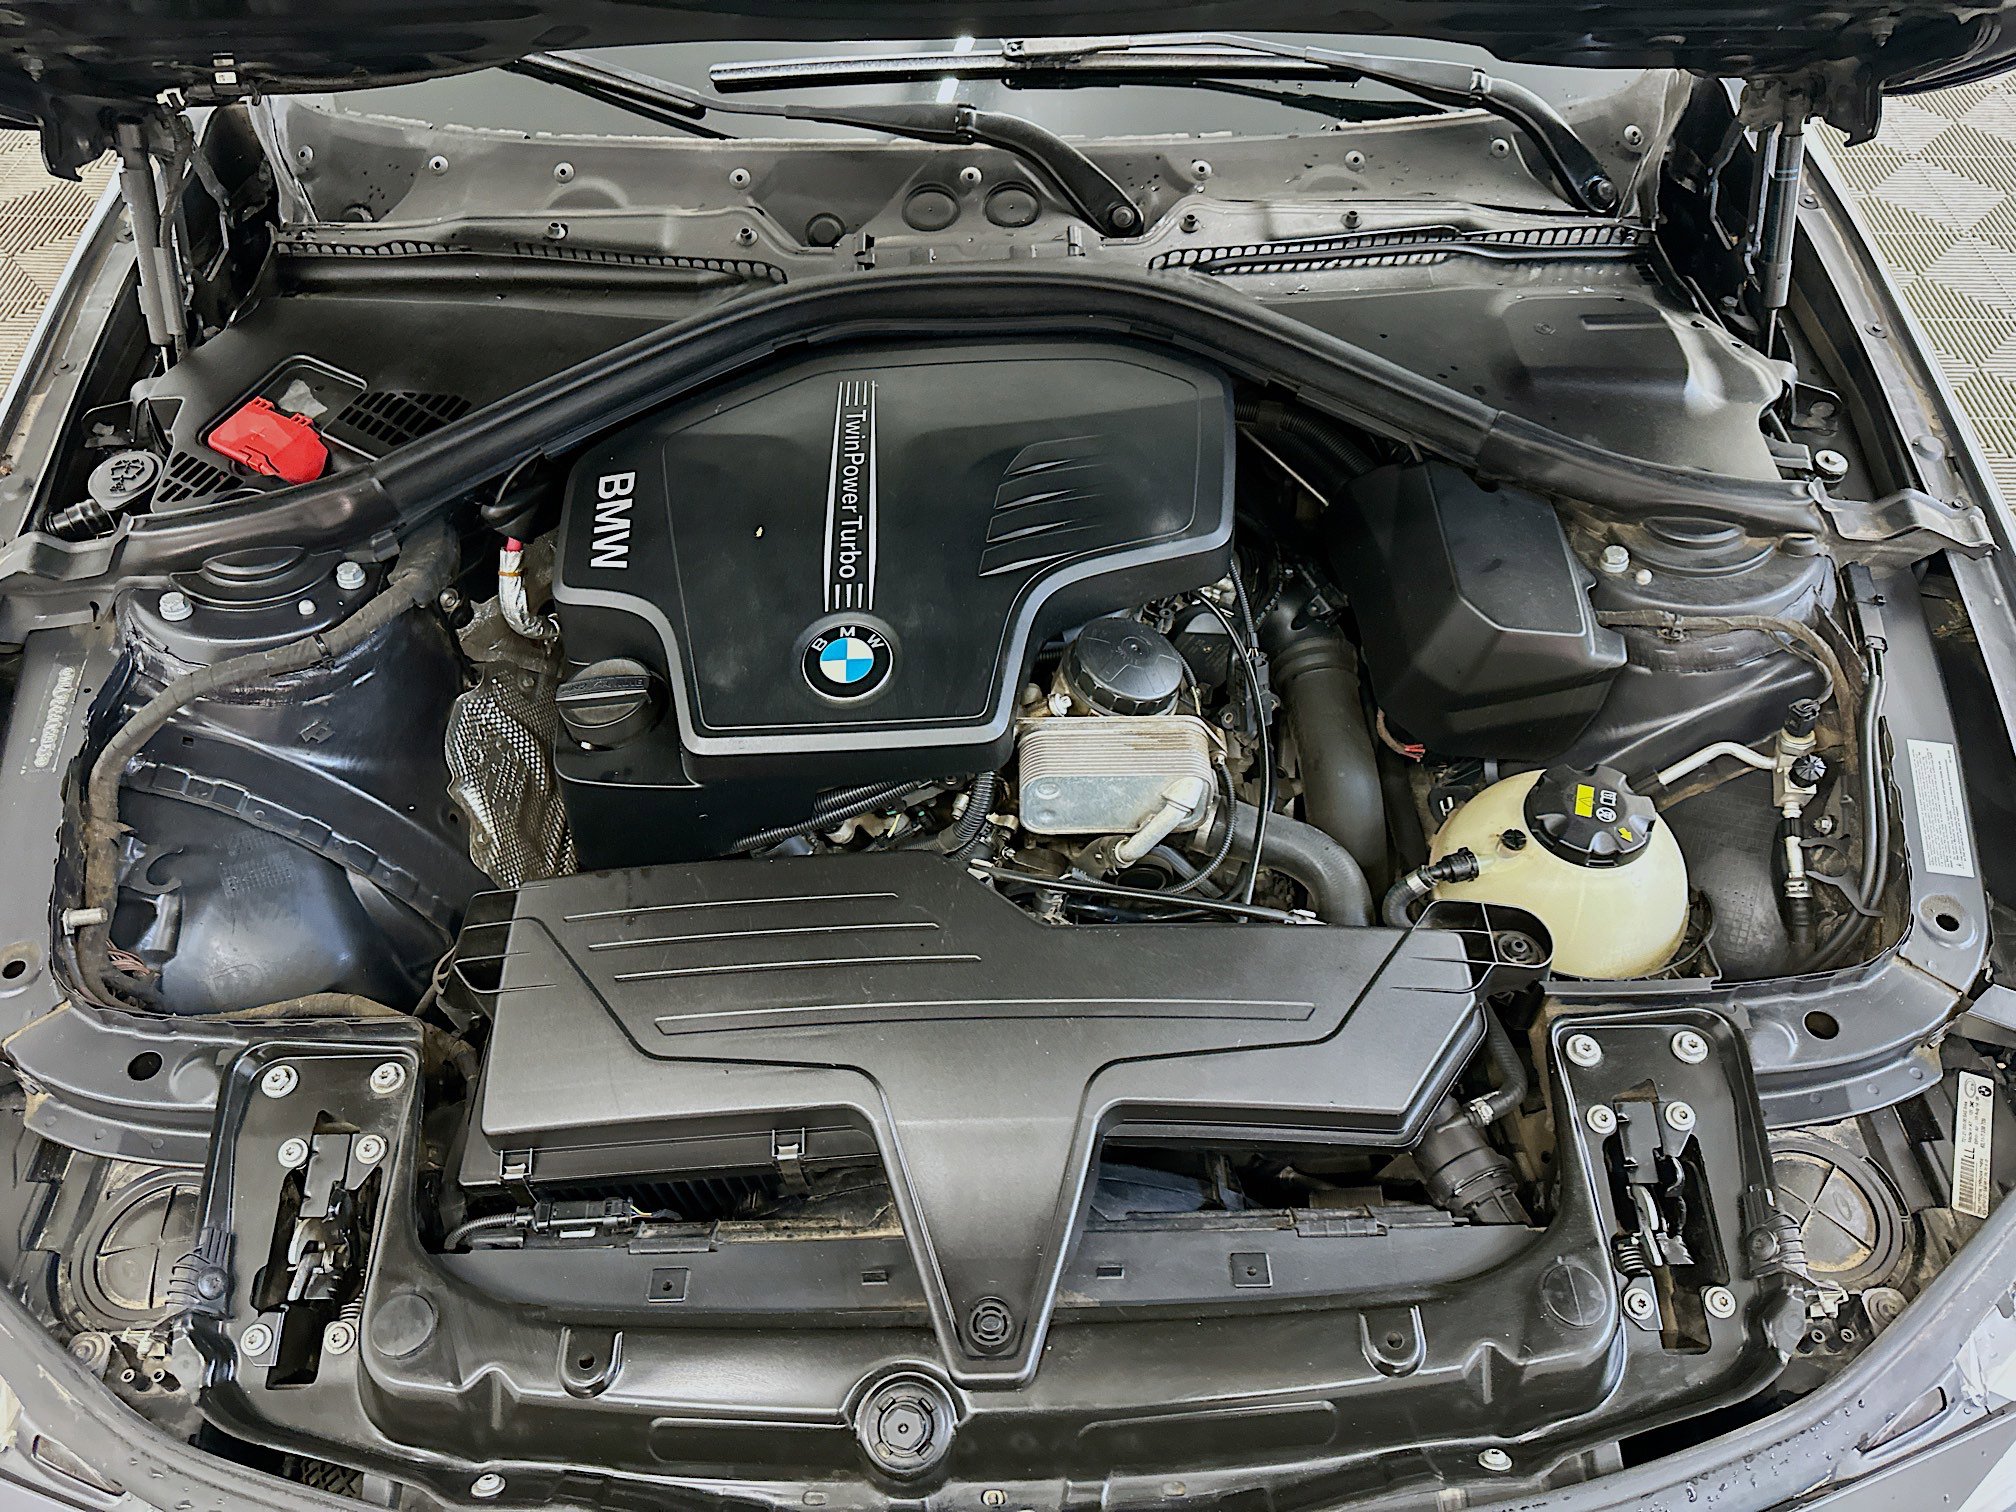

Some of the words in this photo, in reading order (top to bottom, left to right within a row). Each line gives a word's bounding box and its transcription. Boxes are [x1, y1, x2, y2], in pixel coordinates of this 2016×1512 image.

[841, 409, 868, 514] TwinPower
[590, 471, 636, 569] BMW
[838, 515, 864, 579] Turbo
[811, 626, 885, 652] BMW
